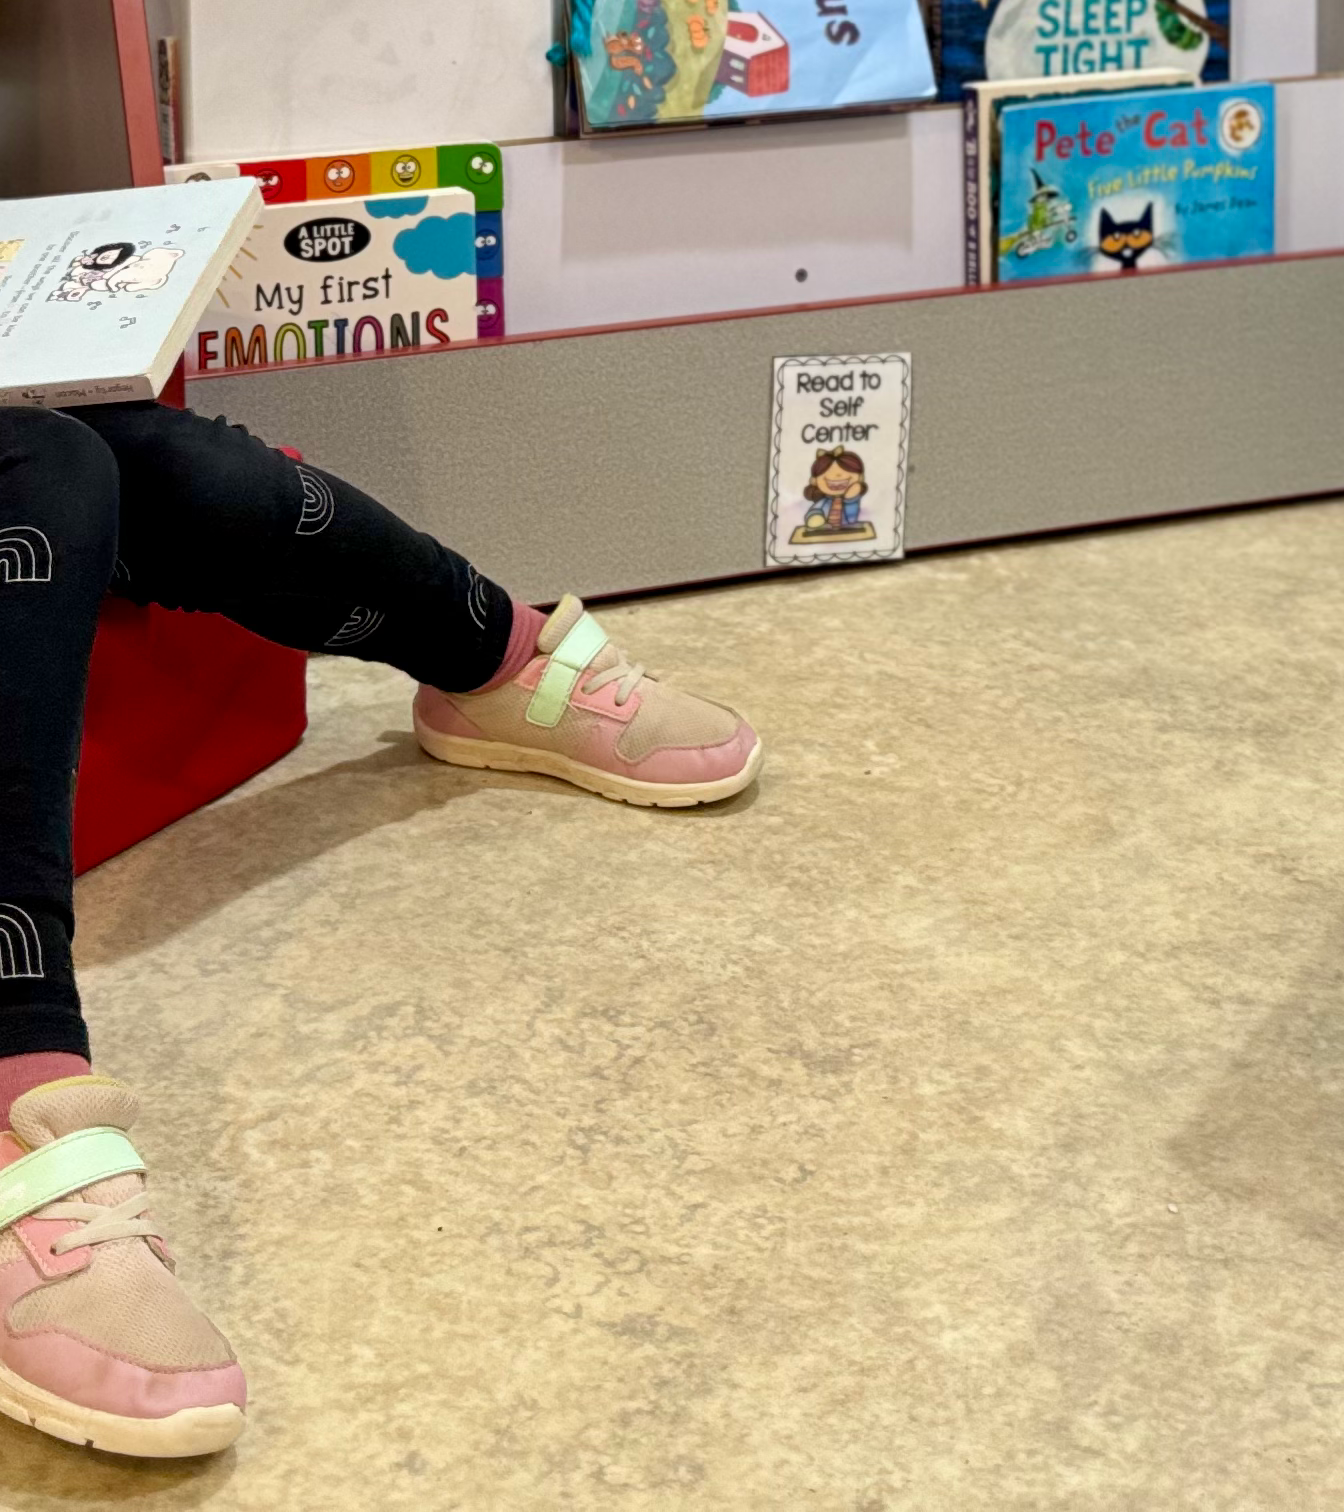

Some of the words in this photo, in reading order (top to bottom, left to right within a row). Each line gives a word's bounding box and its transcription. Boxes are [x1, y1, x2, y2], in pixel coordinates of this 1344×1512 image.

[1035, 37, 1150, 78] TIGHT
[1035, 119, 1115, 162] Pete
[1115, 113, 1142, 135] the
[1143, 110, 1209, 149] Cat
[1087, 178, 1123, 199] Five
[1127, 166, 1178, 187] Little
[1183, 159, 1259, 184] Pumpkins
[298, 226, 309, 239] A
[312, 222, 355, 238] LITTLE
[299, 235, 355, 259] SPOT
[254, 282, 305, 316] My
[319, 267, 392, 306] first
[198, 307, 451, 371] EMOTIONS
[796, 370, 855, 394] Read
[859, 370, 882, 391] to
[819, 395, 865, 418] Self
[801, 422, 880, 444] Center
